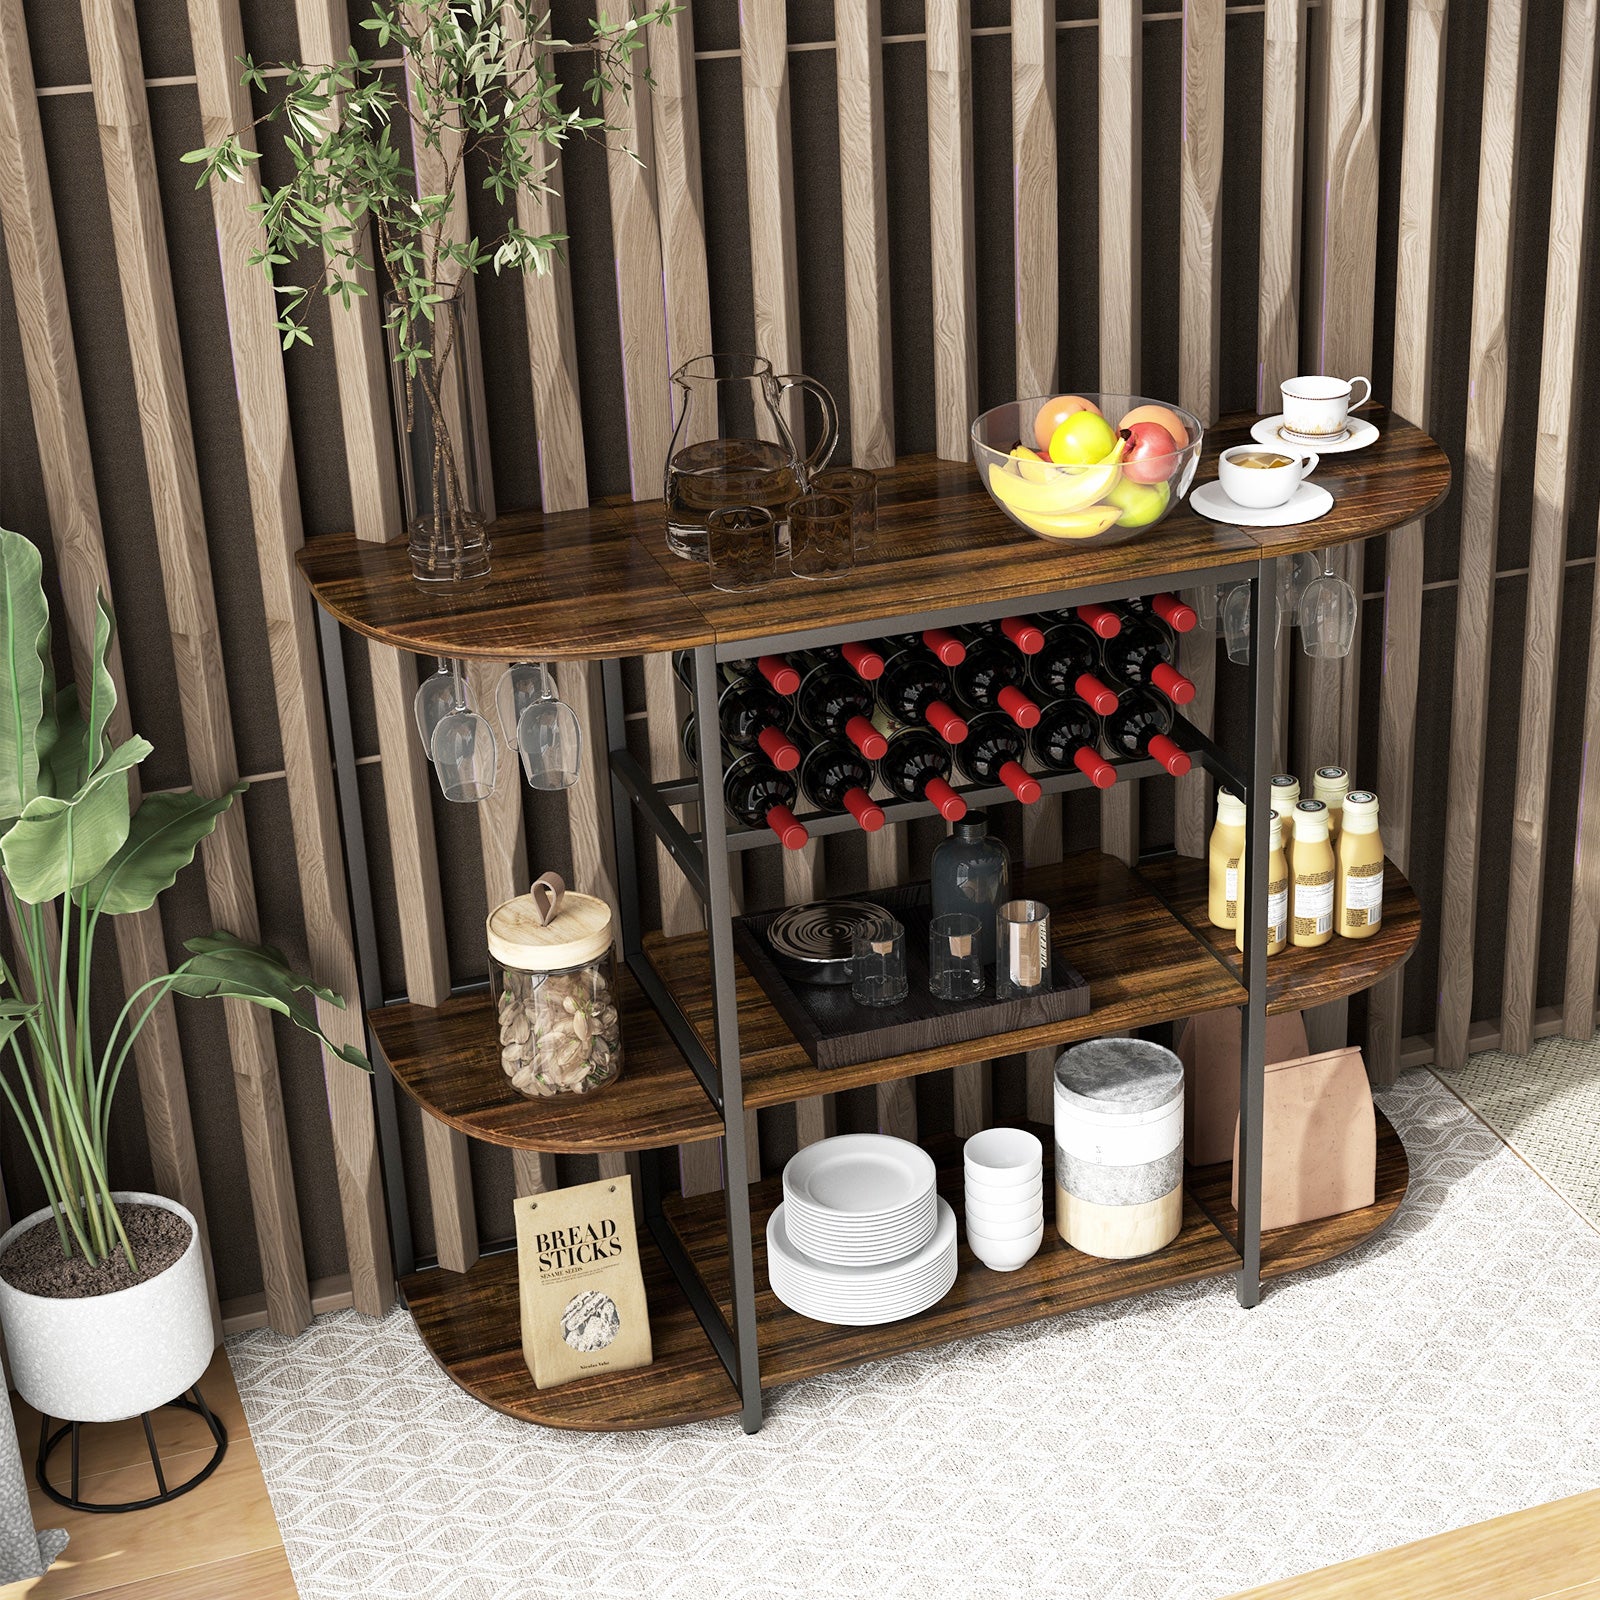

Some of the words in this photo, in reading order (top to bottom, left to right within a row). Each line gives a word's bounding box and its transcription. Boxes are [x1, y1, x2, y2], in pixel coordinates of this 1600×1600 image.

[534, 1219, 616, 1254] BREAD
[538, 1237, 622, 1272] STICKS
[540, 1270, 563, 1280] SESAME
[565, 1267, 583, 1275] SEEDS
